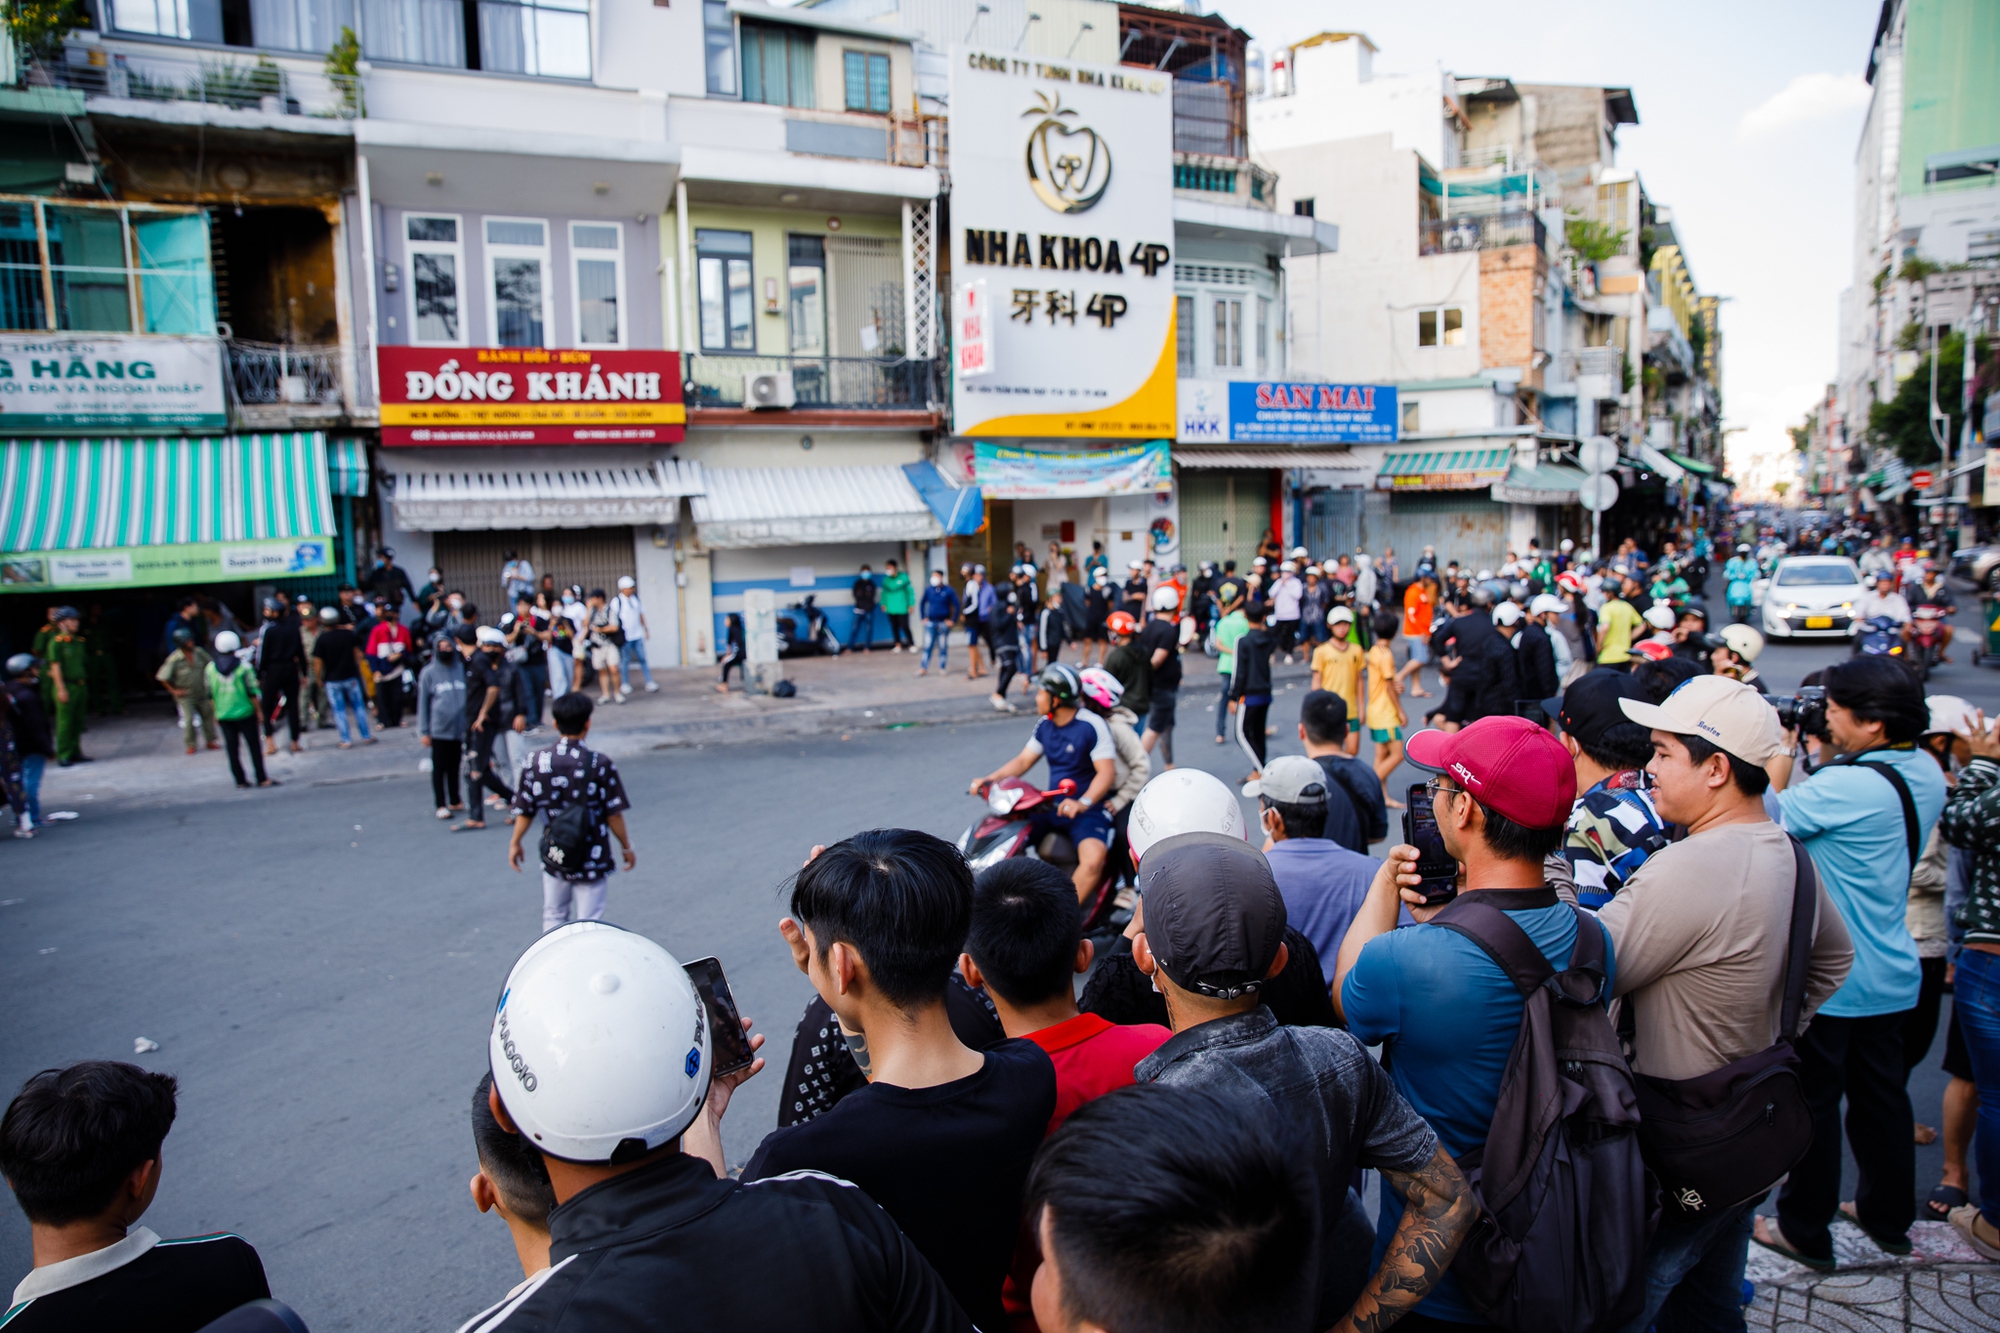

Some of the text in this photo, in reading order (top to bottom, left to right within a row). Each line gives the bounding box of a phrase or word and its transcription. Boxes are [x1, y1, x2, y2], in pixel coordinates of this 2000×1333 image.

[1012, 60, 1029, 76] TY
[965, 228, 1171, 277] NHA KHOA 4P
[1011, 288, 1078, 326] 牙科
[405, 359, 662, 401] ĐỒNG KHÁNH
[1255, 382, 1376, 411] SAN MAI
[1184, 420, 1221, 434] HKK
[499, 1008, 538, 1093] PIAGGIO
